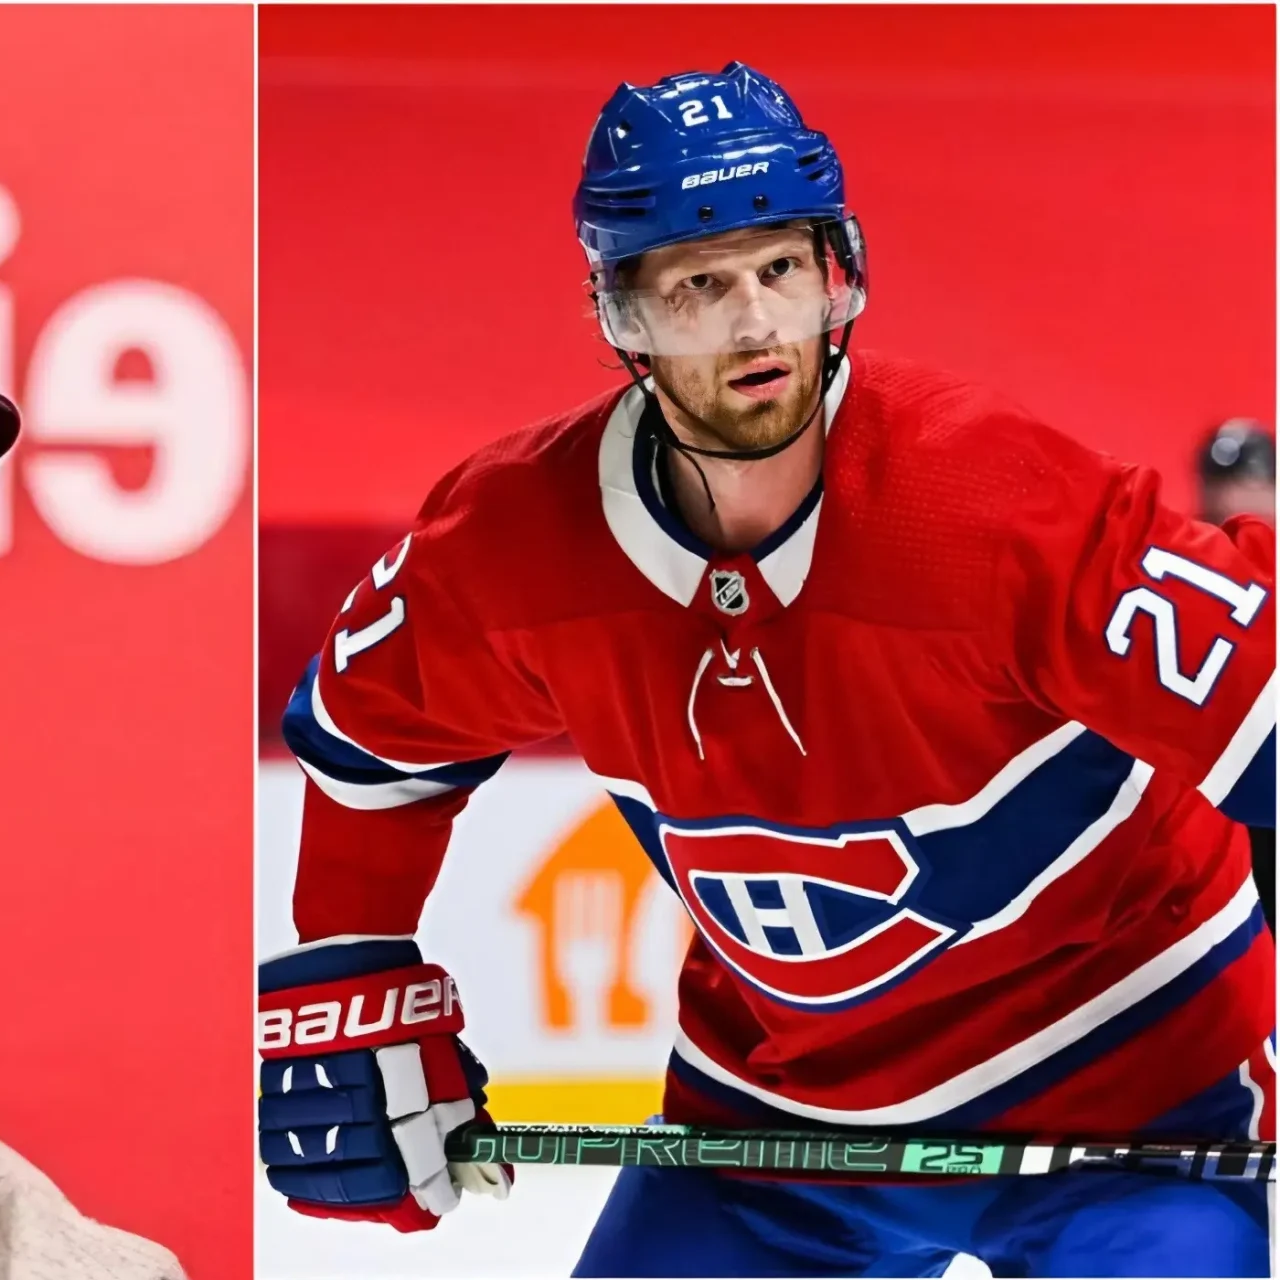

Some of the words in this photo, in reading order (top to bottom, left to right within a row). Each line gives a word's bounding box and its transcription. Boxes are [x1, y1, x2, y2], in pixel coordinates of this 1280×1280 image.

[678, 95, 733, 128] 21
[681, 160, 770, 190] BAUER
[1105, 546, 1269, 708] 21
